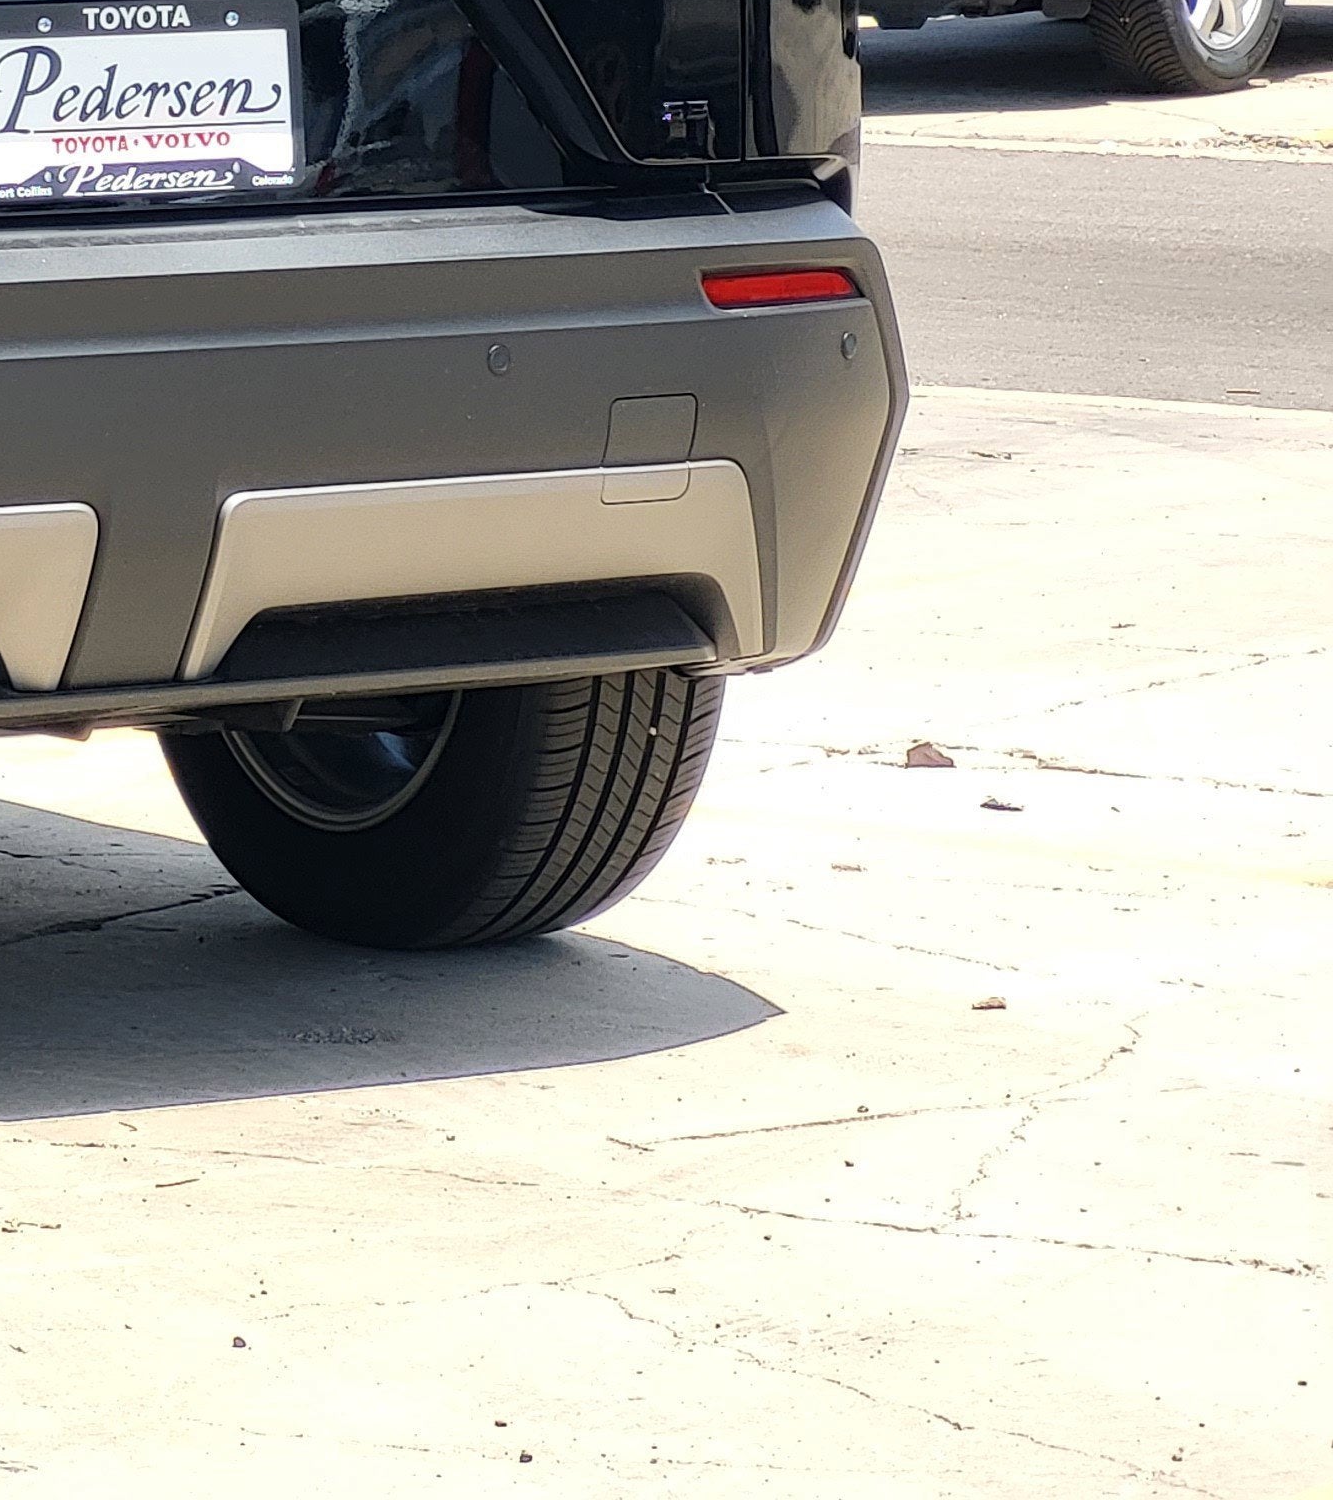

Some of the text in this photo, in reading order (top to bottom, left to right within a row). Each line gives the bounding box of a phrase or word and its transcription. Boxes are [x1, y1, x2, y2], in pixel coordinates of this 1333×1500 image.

[82, 4, 191, 31] TOYOTA
[51, 132, 231, 155] TOYOTA VOLVO
[58, 162, 235, 197] Pedersen
